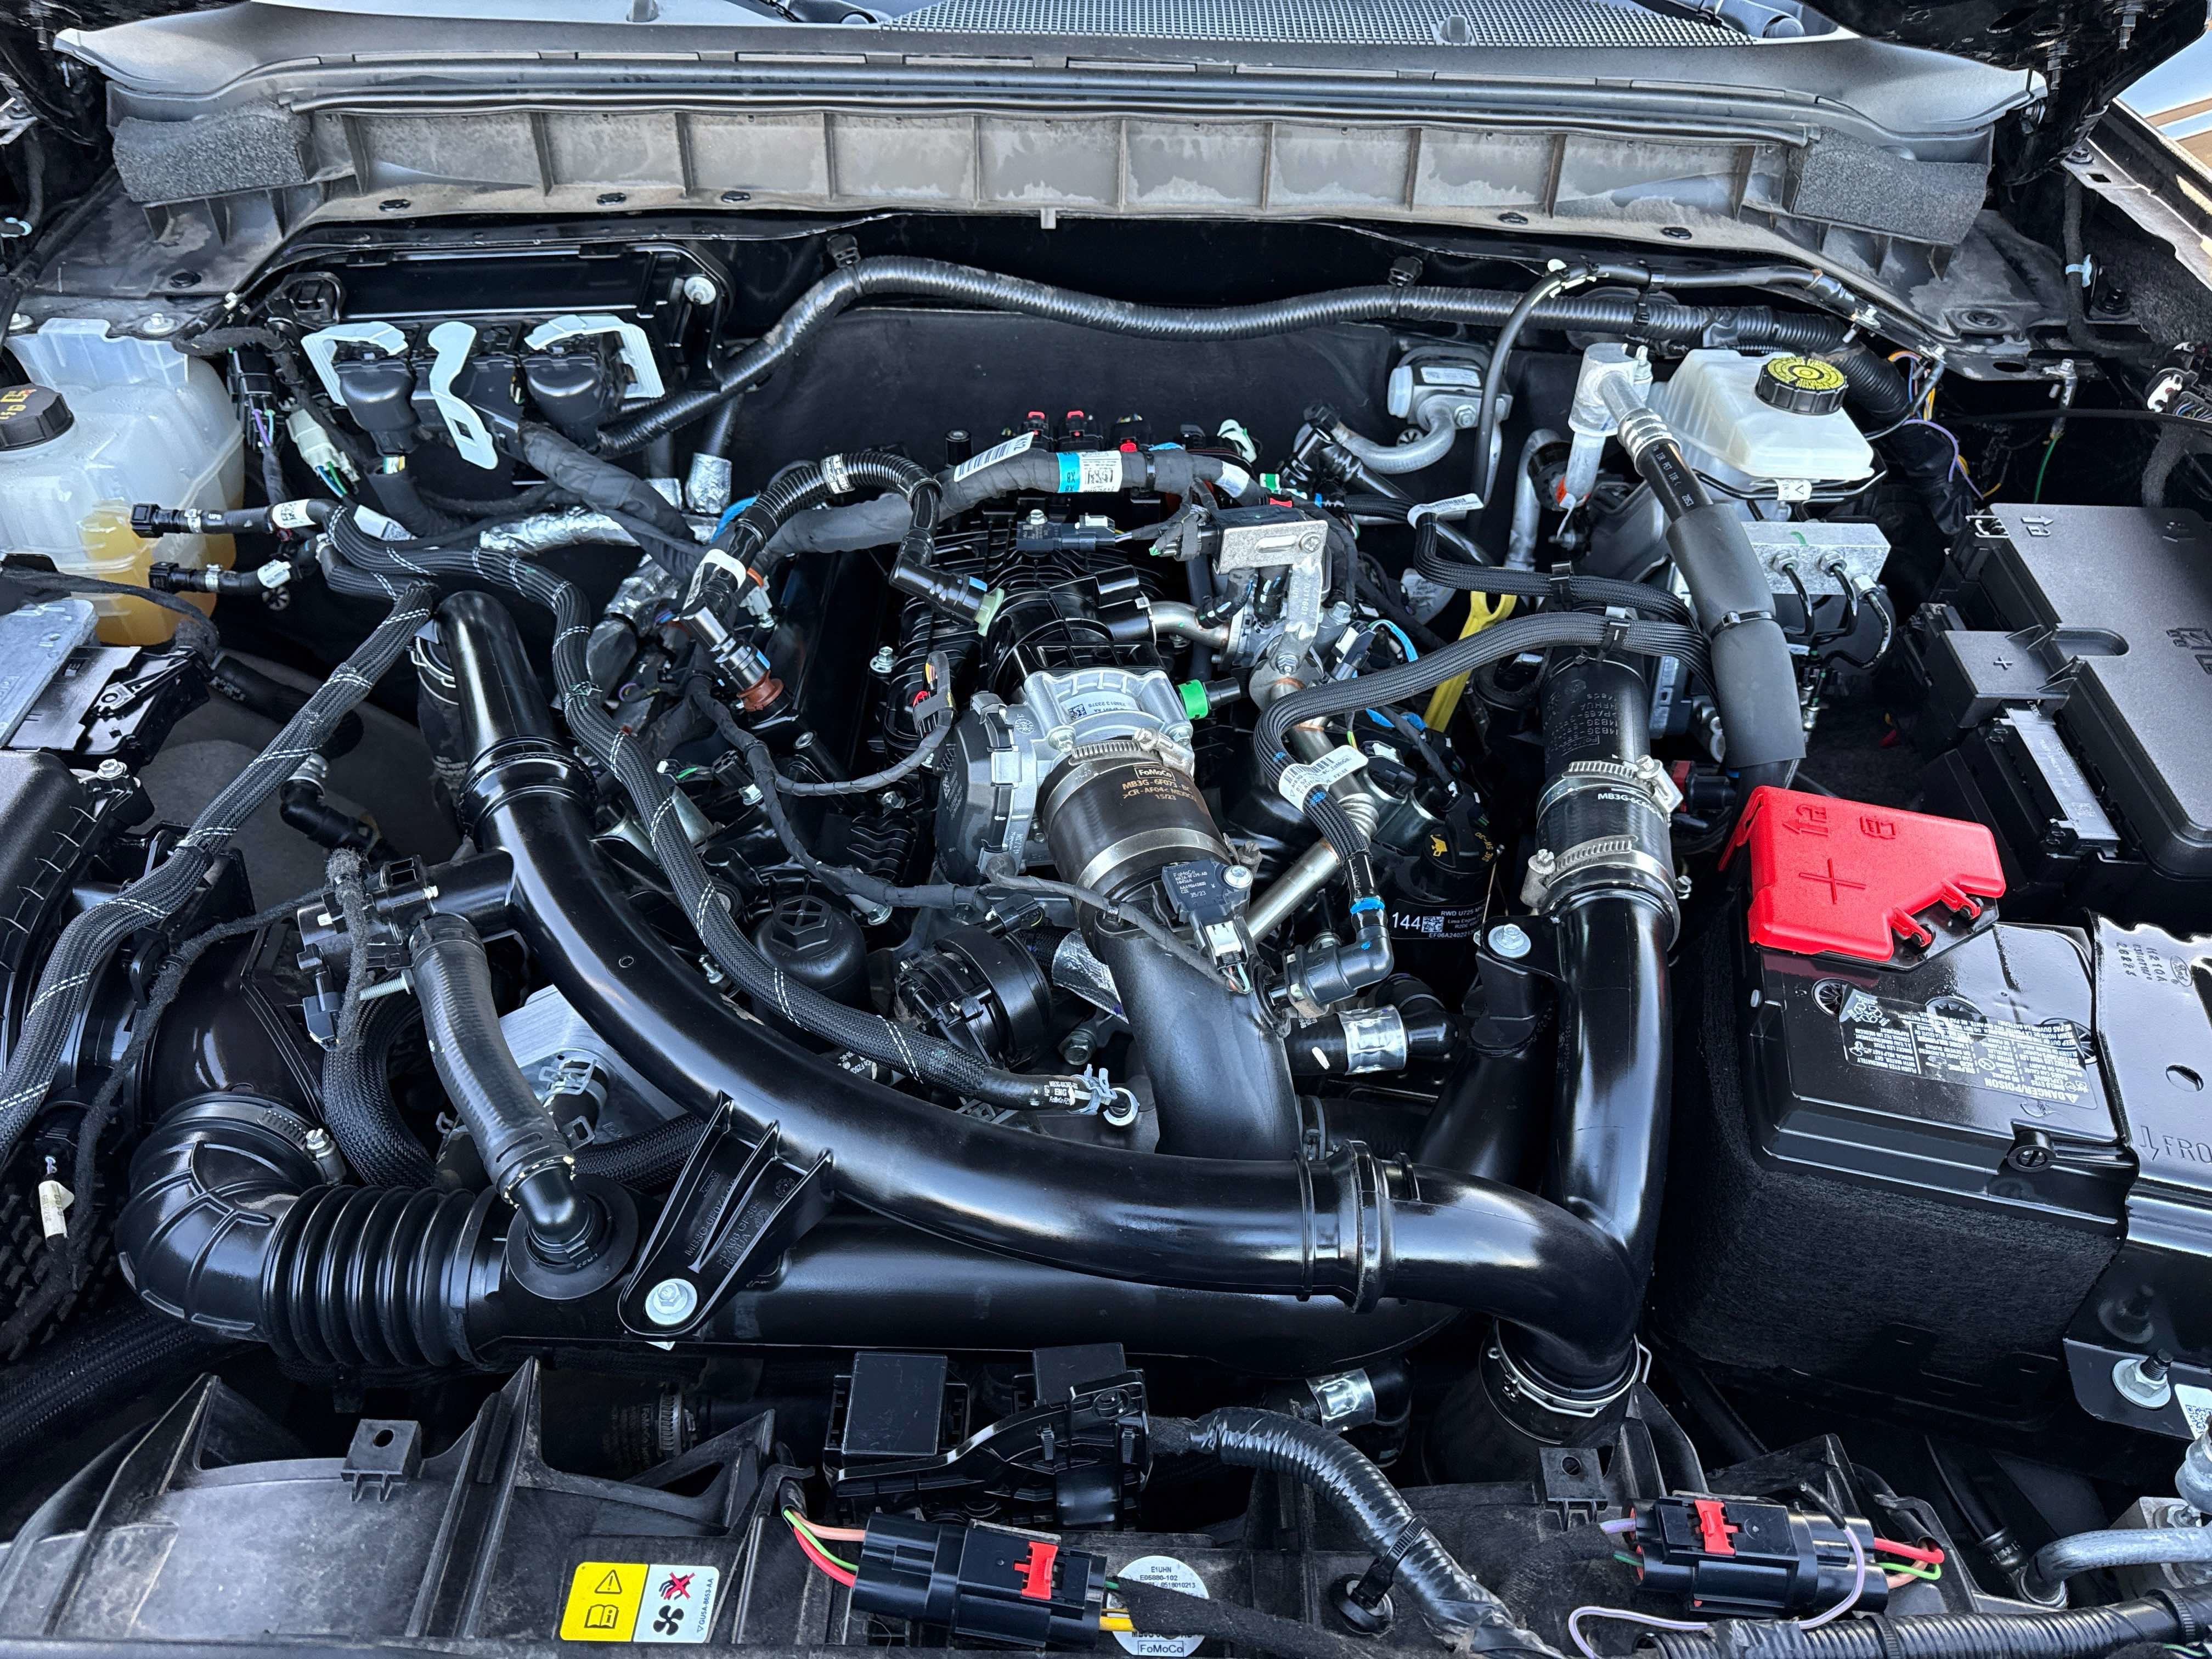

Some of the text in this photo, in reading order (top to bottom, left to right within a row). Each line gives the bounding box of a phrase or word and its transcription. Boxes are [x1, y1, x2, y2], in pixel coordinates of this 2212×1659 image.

[1138, 769, 1171, 777] FoMoCo
[1482, 851, 1493, 862] SAE
[1392, 912, 1420, 929] 144
[1054, 1088, 1067, 1096] ENG
[1983, 1077, 2066, 1100] DANGER/POISON
